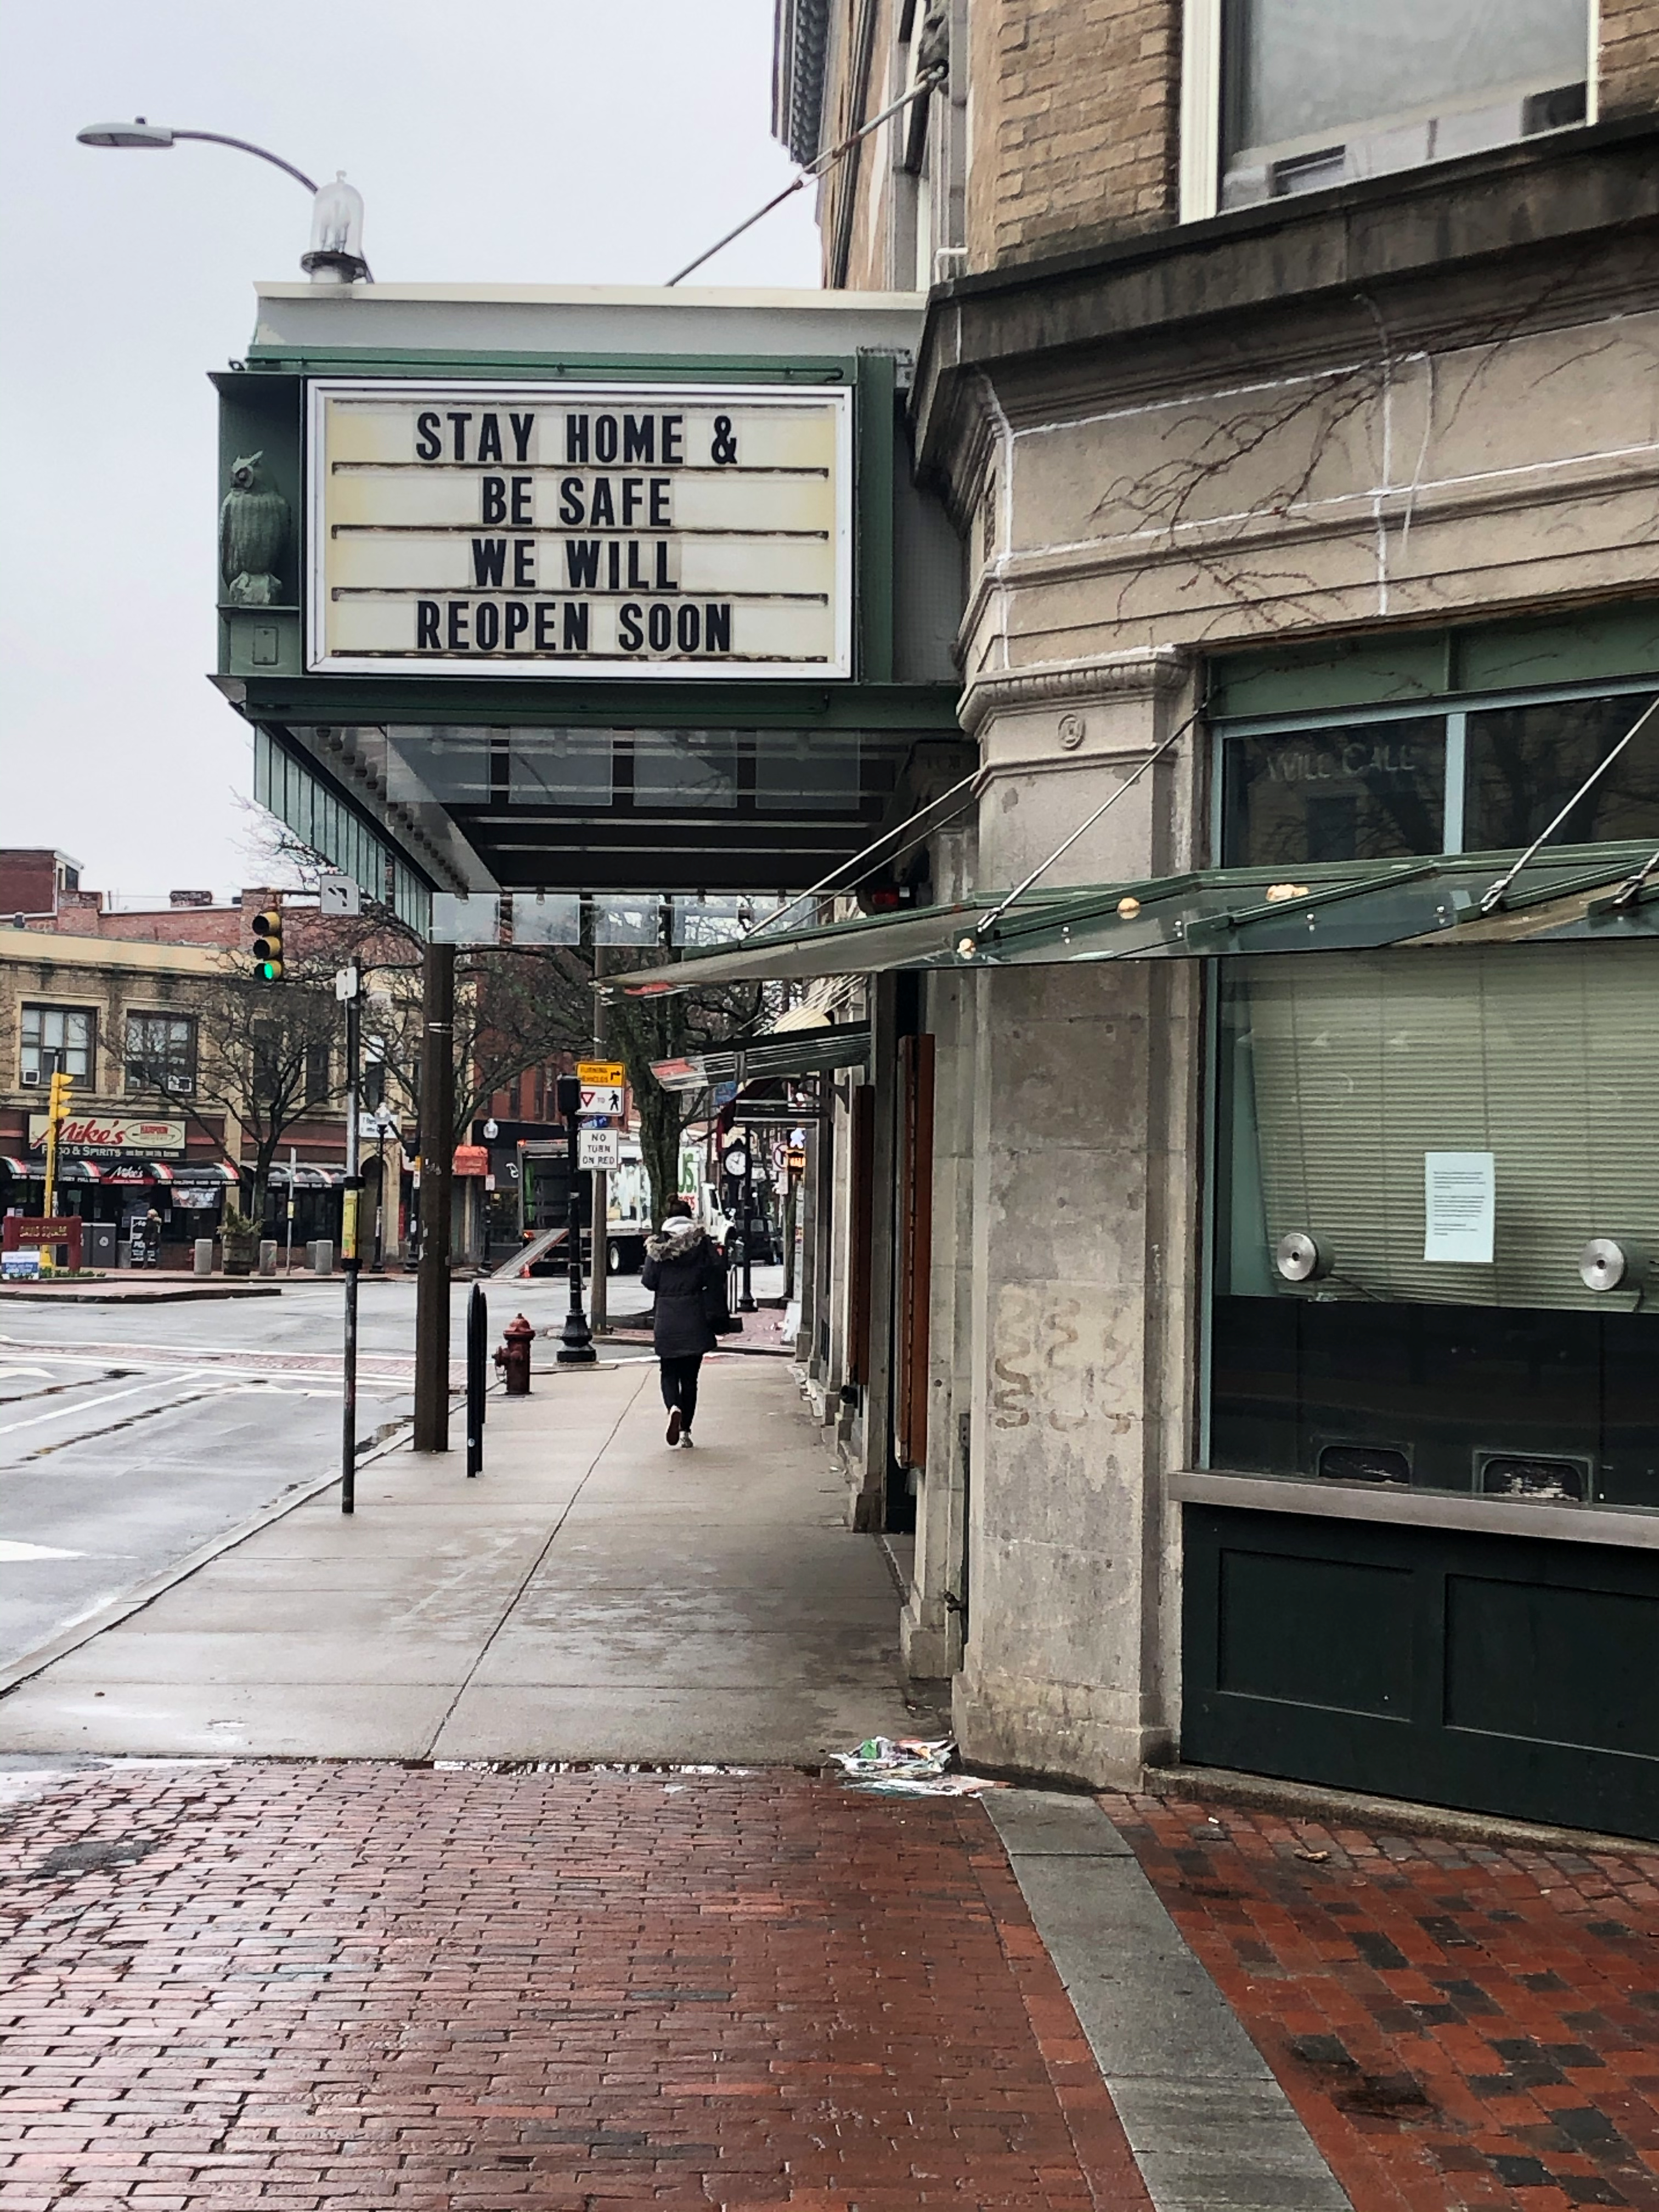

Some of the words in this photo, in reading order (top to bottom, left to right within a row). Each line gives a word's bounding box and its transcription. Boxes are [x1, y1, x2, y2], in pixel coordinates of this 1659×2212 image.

[416, 413, 534, 462] STAY
[567, 415, 682, 464] HOME
[712, 415, 737, 464] &
[483, 477, 532, 525] BE
[560, 477, 671, 526] SAFE
[472, 539, 535, 588] WE
[566, 540, 678, 589] WILL
[416, 601, 589, 651] REOPEN
[619, 603, 731, 652] SOON
[1342, 743, 1415, 774] CALL
[30, 1119, 126, 1150] Mike's
[588, 1145, 611, 1153] TURN
[591, 1133, 606, 1142] NO
[72, 1146, 81, 1155] &
[583, 1155, 594, 1164] ON
[598, 1156, 614, 1165] RED
